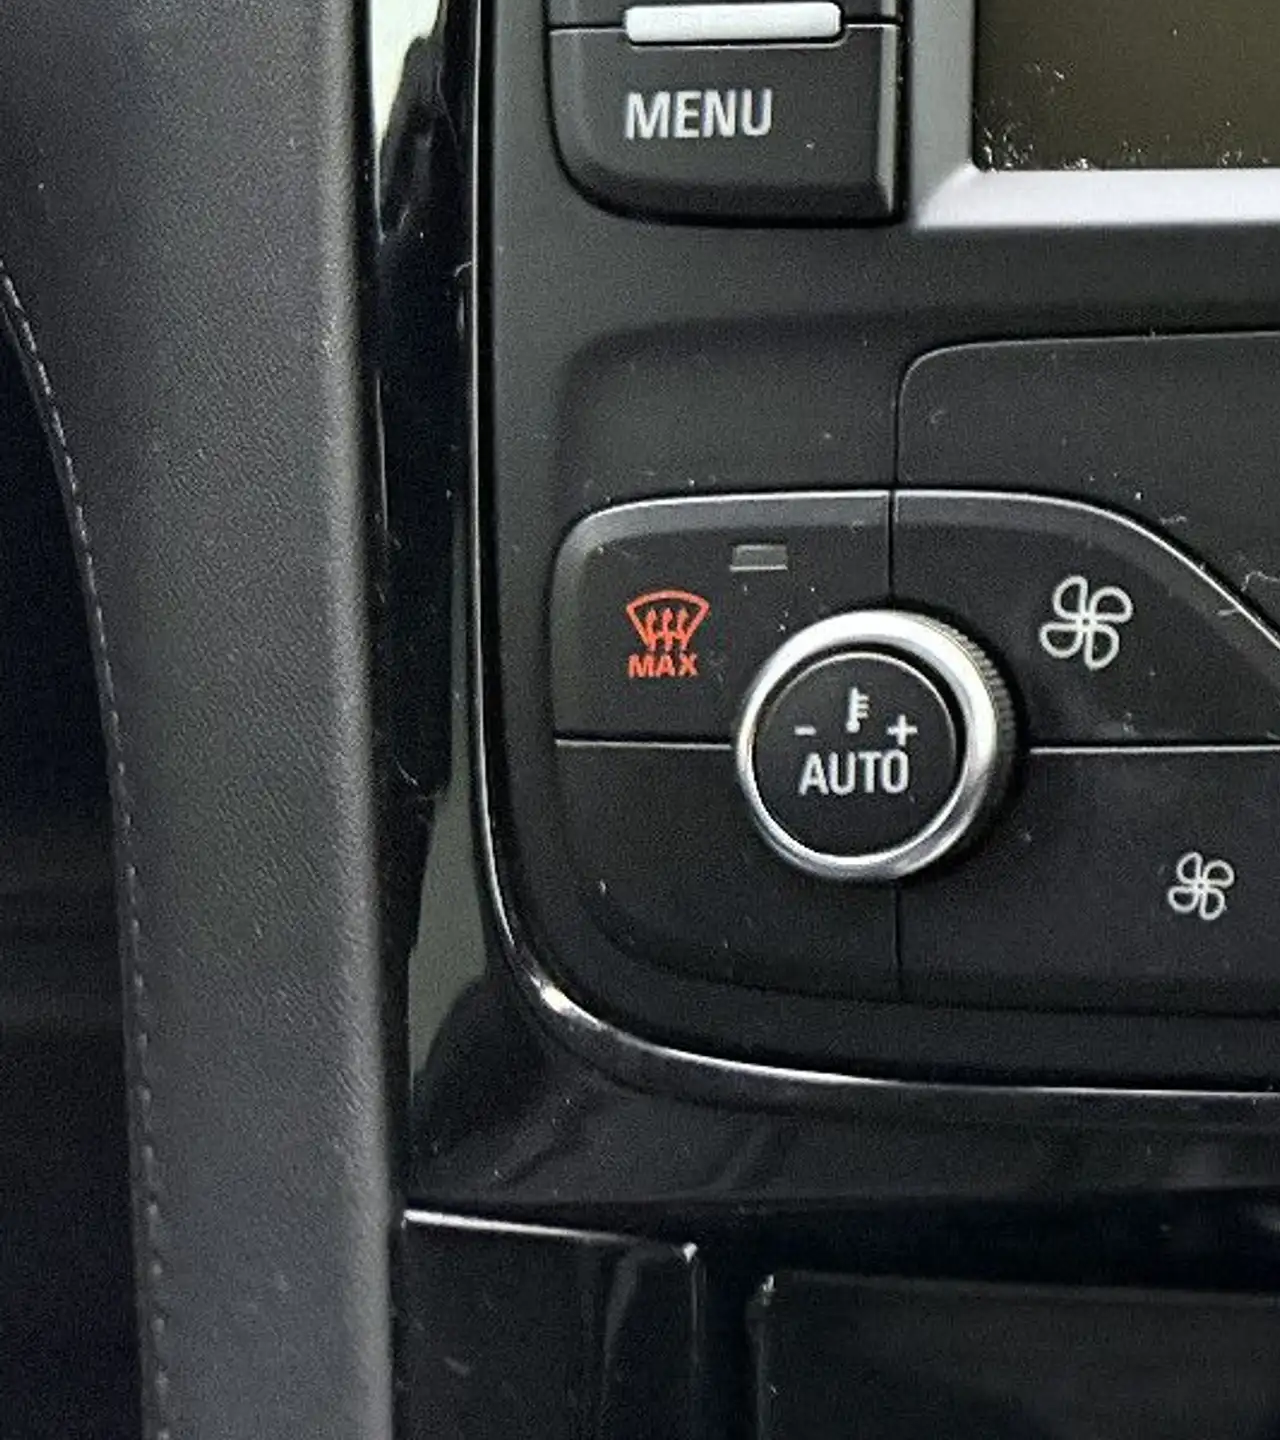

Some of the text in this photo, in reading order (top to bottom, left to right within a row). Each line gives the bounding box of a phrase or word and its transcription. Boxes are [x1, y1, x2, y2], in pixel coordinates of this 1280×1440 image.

[624, 88, 773, 141] MENU
[627, 651, 698, 679] MAX
[798, 748, 910, 796] AUTO
